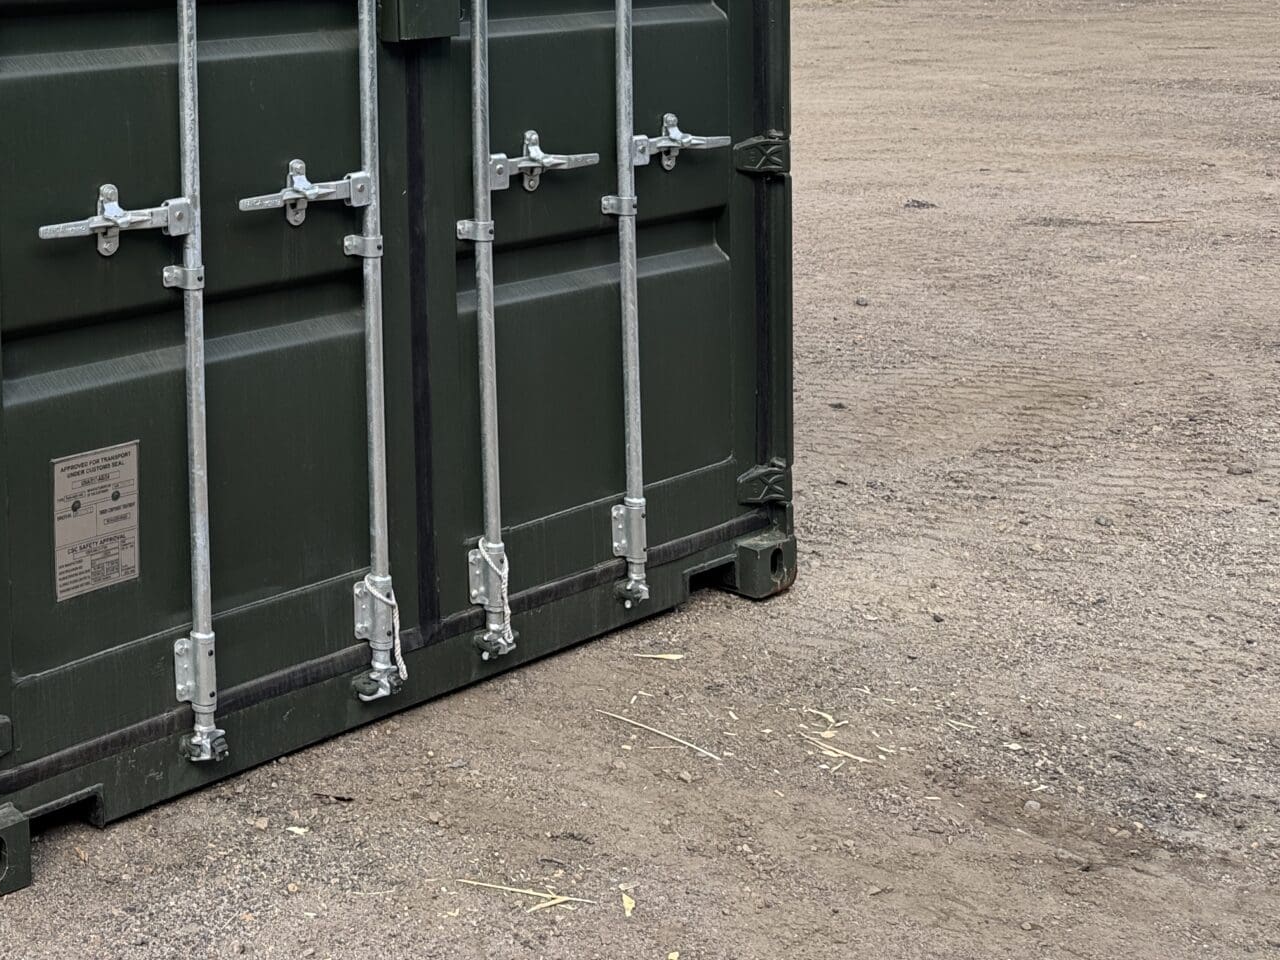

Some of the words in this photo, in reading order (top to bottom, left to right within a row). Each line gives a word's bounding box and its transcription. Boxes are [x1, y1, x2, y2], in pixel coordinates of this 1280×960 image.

[60, 461, 88, 473] APPROVED
[101, 451, 131, 462] TRANSPORT
[66, 469, 85, 478] UNDER
[86, 463, 111, 474] CUSTOMS
